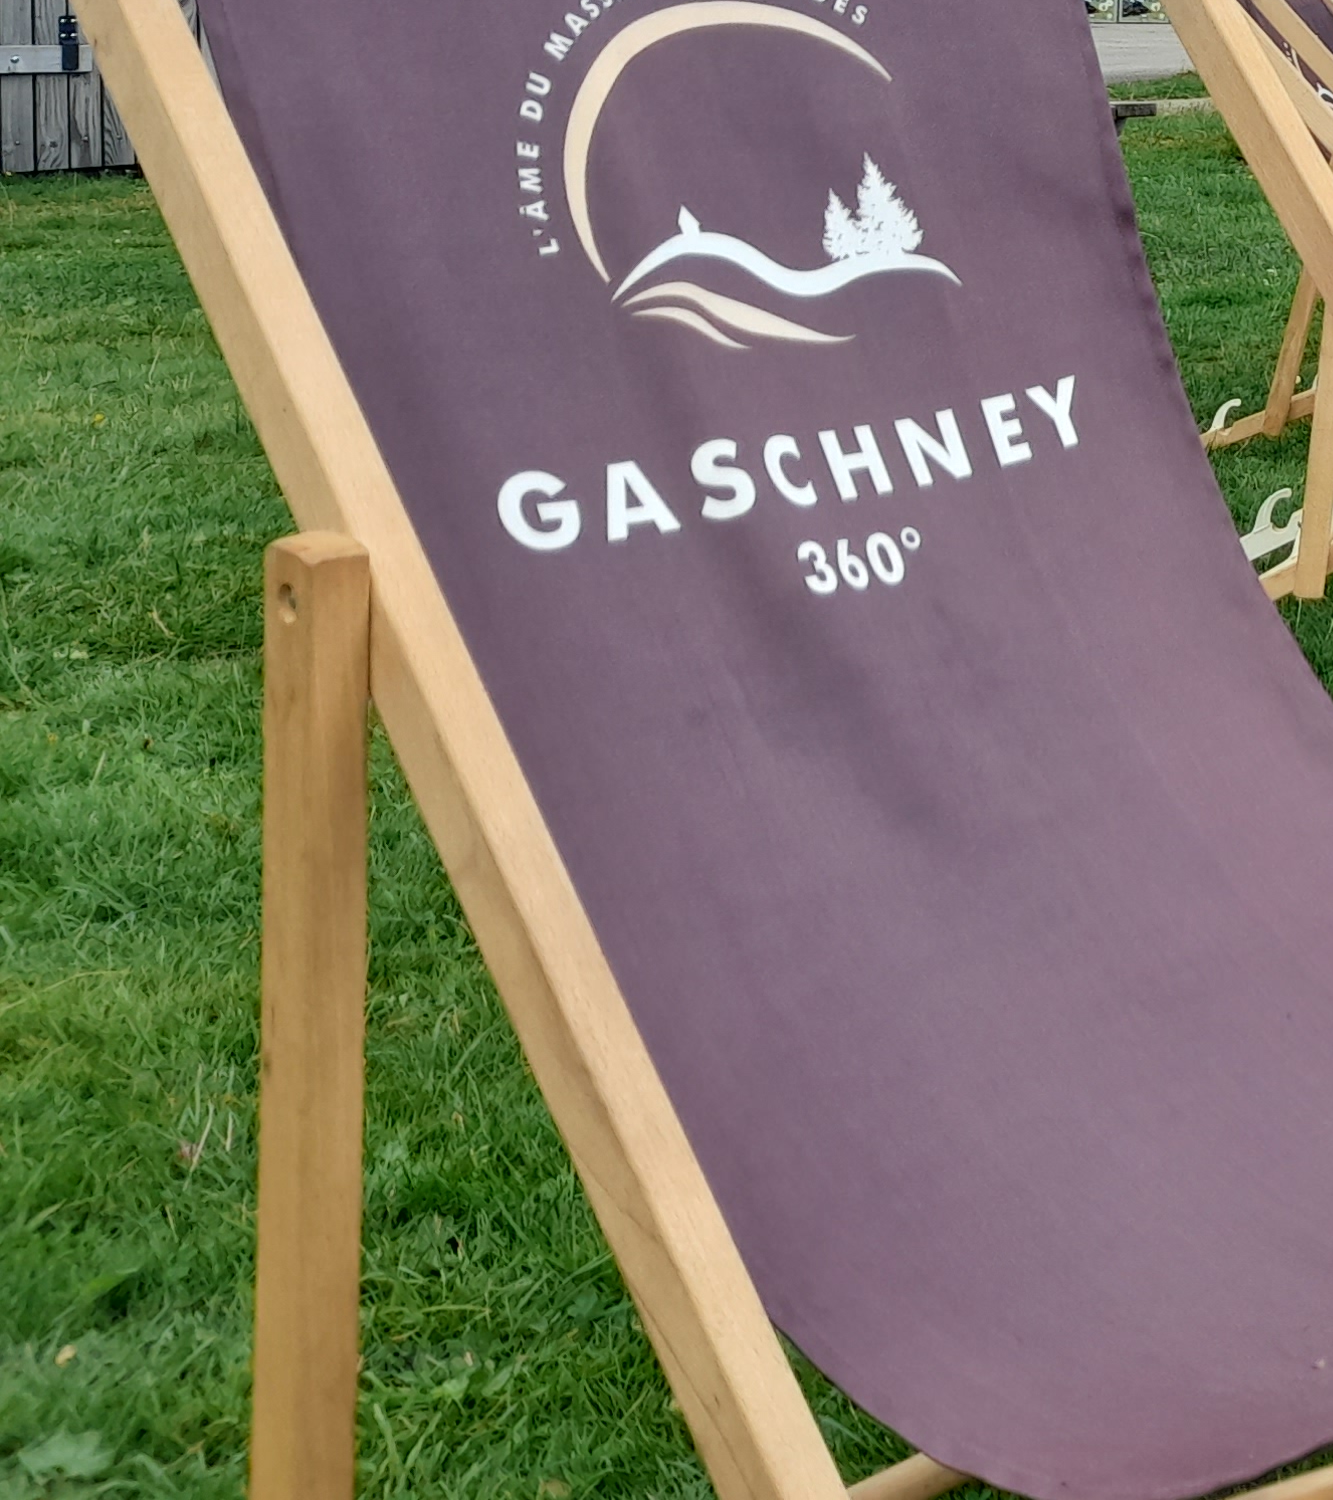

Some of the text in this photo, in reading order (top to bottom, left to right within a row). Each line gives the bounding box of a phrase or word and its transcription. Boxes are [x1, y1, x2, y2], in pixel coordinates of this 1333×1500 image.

[519, 71, 552, 123] DU
[496, 374, 1079, 552] GASCHNEY
[797, 526, 921, 595] 360°
